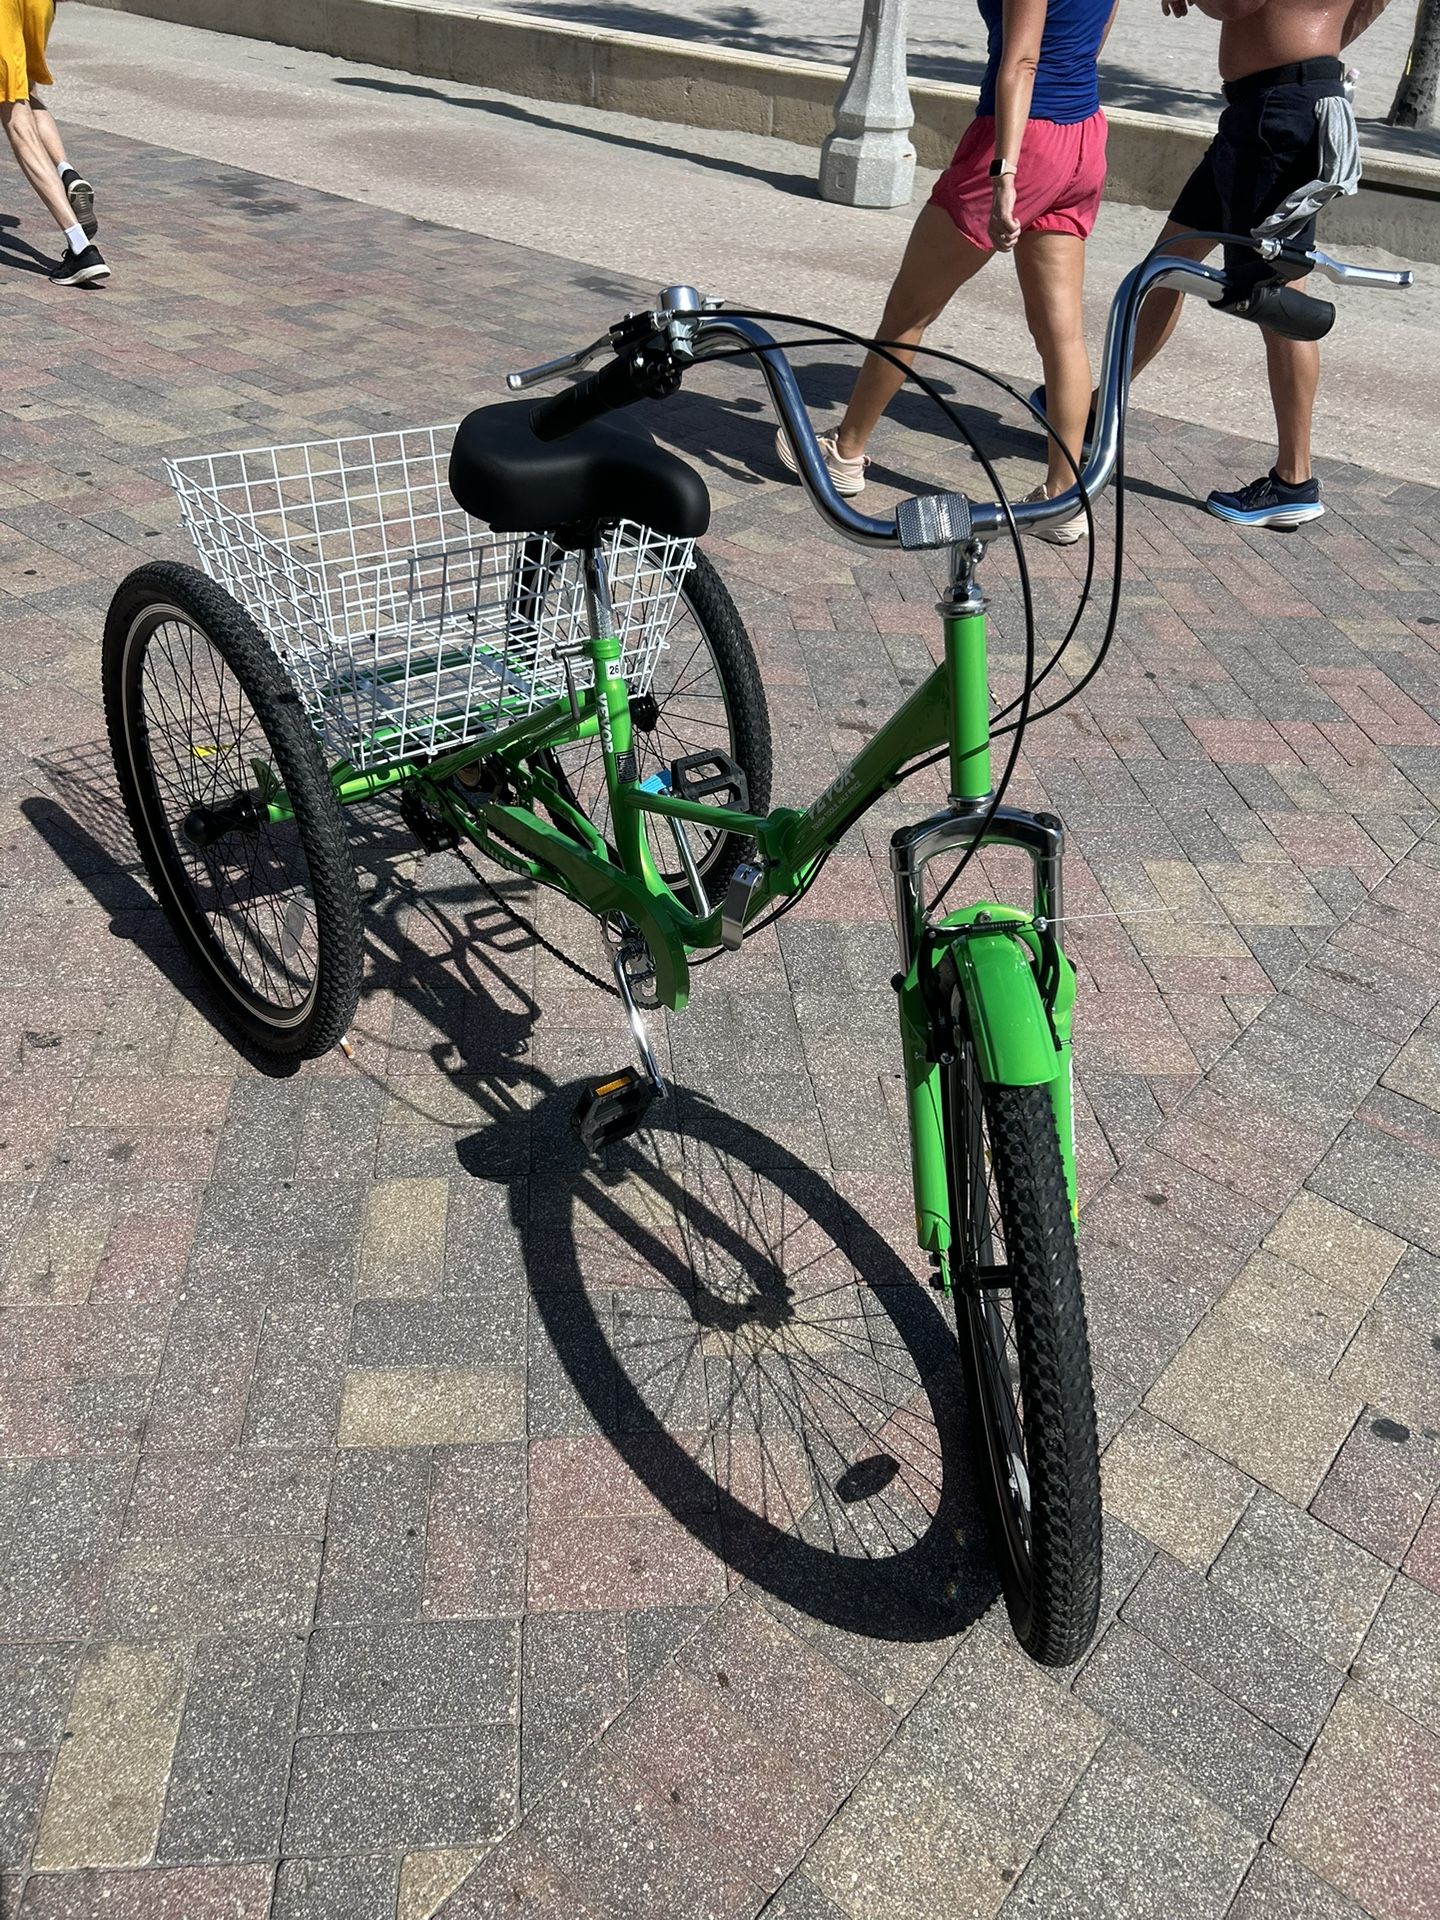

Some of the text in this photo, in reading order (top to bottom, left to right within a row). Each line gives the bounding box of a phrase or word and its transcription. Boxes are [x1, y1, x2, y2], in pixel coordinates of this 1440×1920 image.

[609, 664, 620, 676] 26
[598, 692, 614, 754] VEVOR
[808, 767, 856, 820] VEVOR
